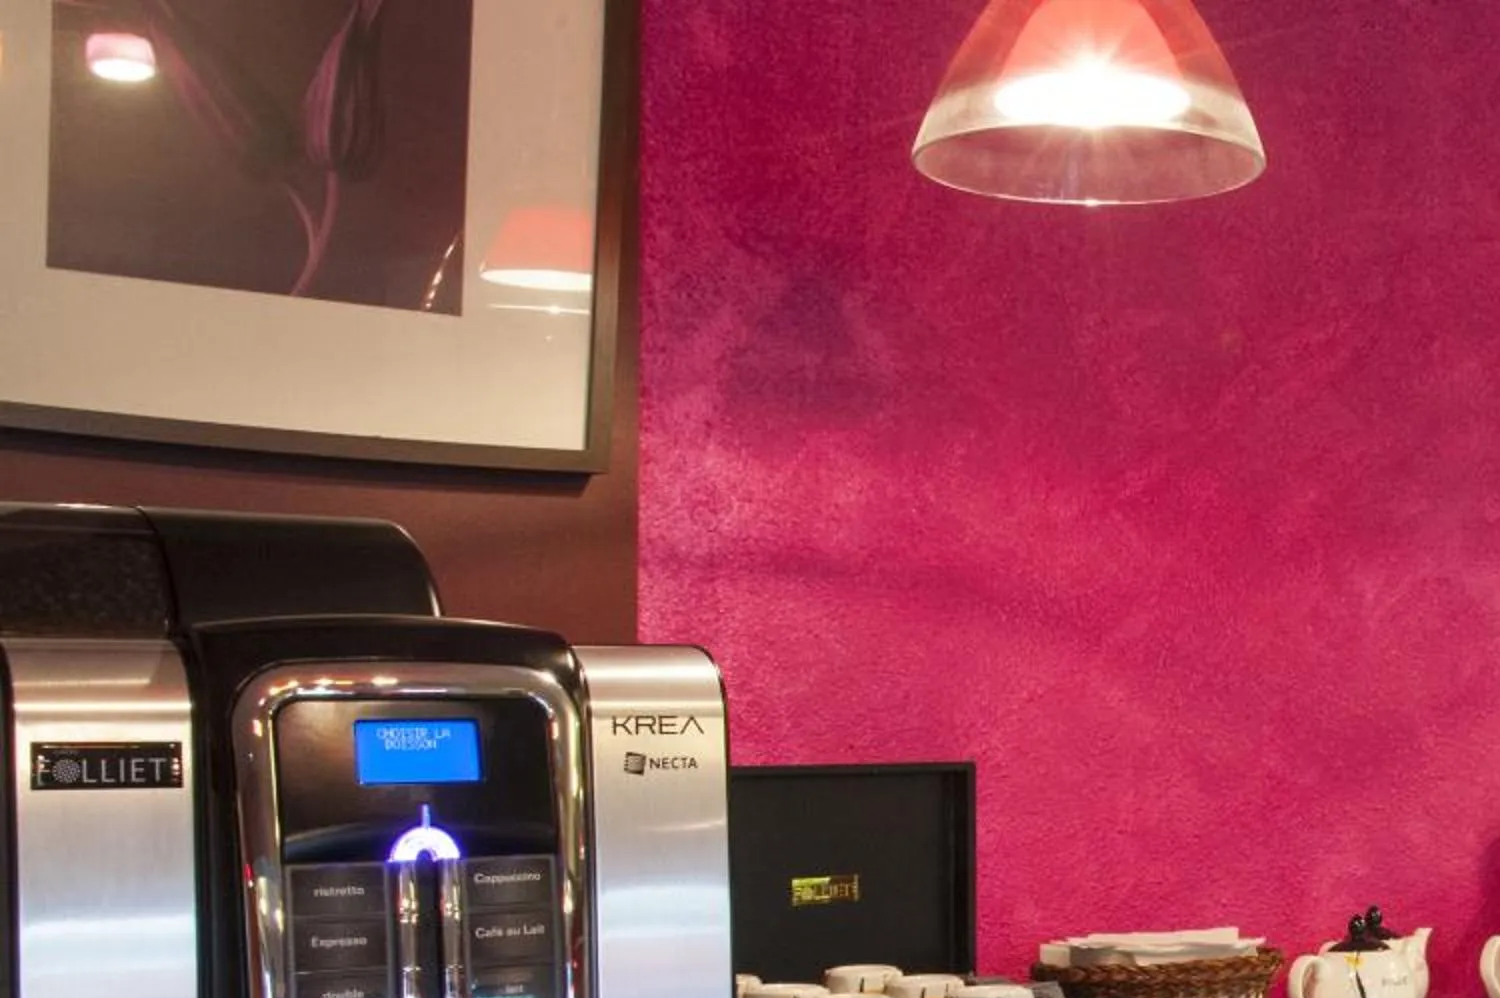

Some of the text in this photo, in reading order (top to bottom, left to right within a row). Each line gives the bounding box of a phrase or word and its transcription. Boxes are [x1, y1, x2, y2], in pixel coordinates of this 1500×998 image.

[611, 714, 705, 736] KREA
[36, 757, 167, 786] FOLLIET
[648, 756, 699, 770] NECTA
[523, 923, 546, 936] Lait
